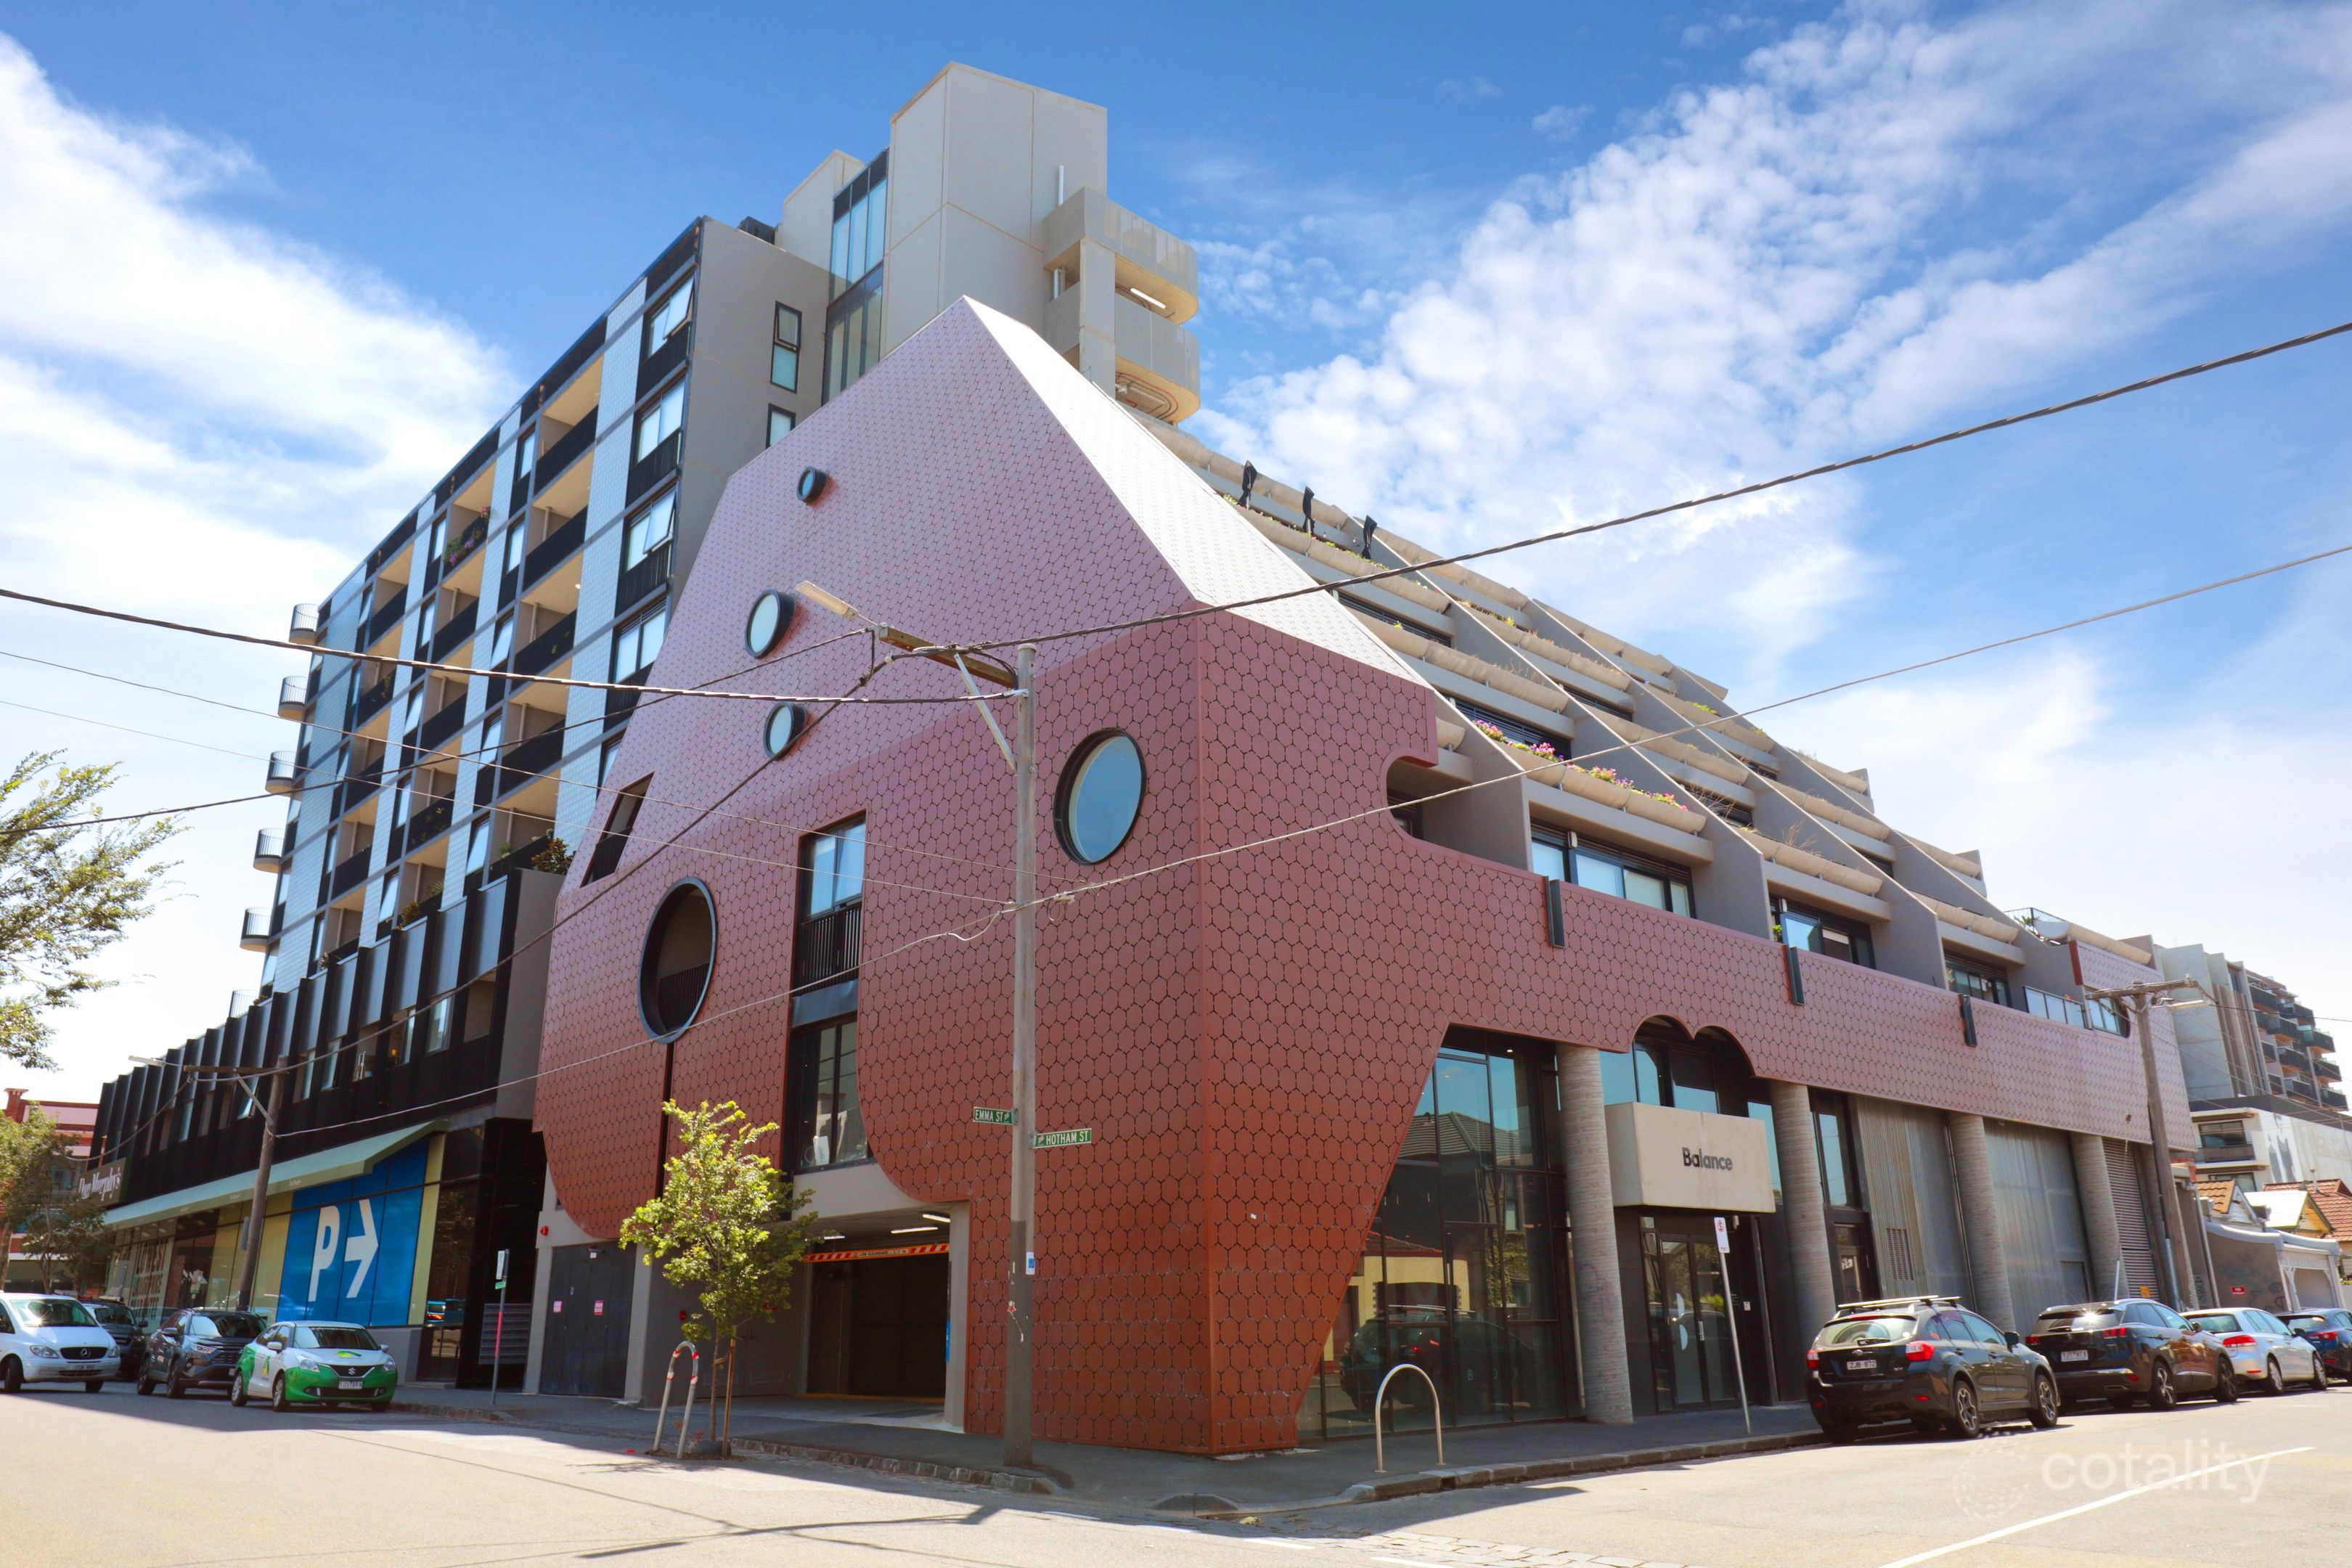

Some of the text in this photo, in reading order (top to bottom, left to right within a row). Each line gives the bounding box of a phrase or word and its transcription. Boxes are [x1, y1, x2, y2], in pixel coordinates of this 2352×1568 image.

[975, 1111, 1004, 1122] EMMA ST
[1046, 1130, 1089, 1146] HOTHAM ST
[1682, 1147, 1733, 1171] Balance
[308, 1205, 340, 1302] P
